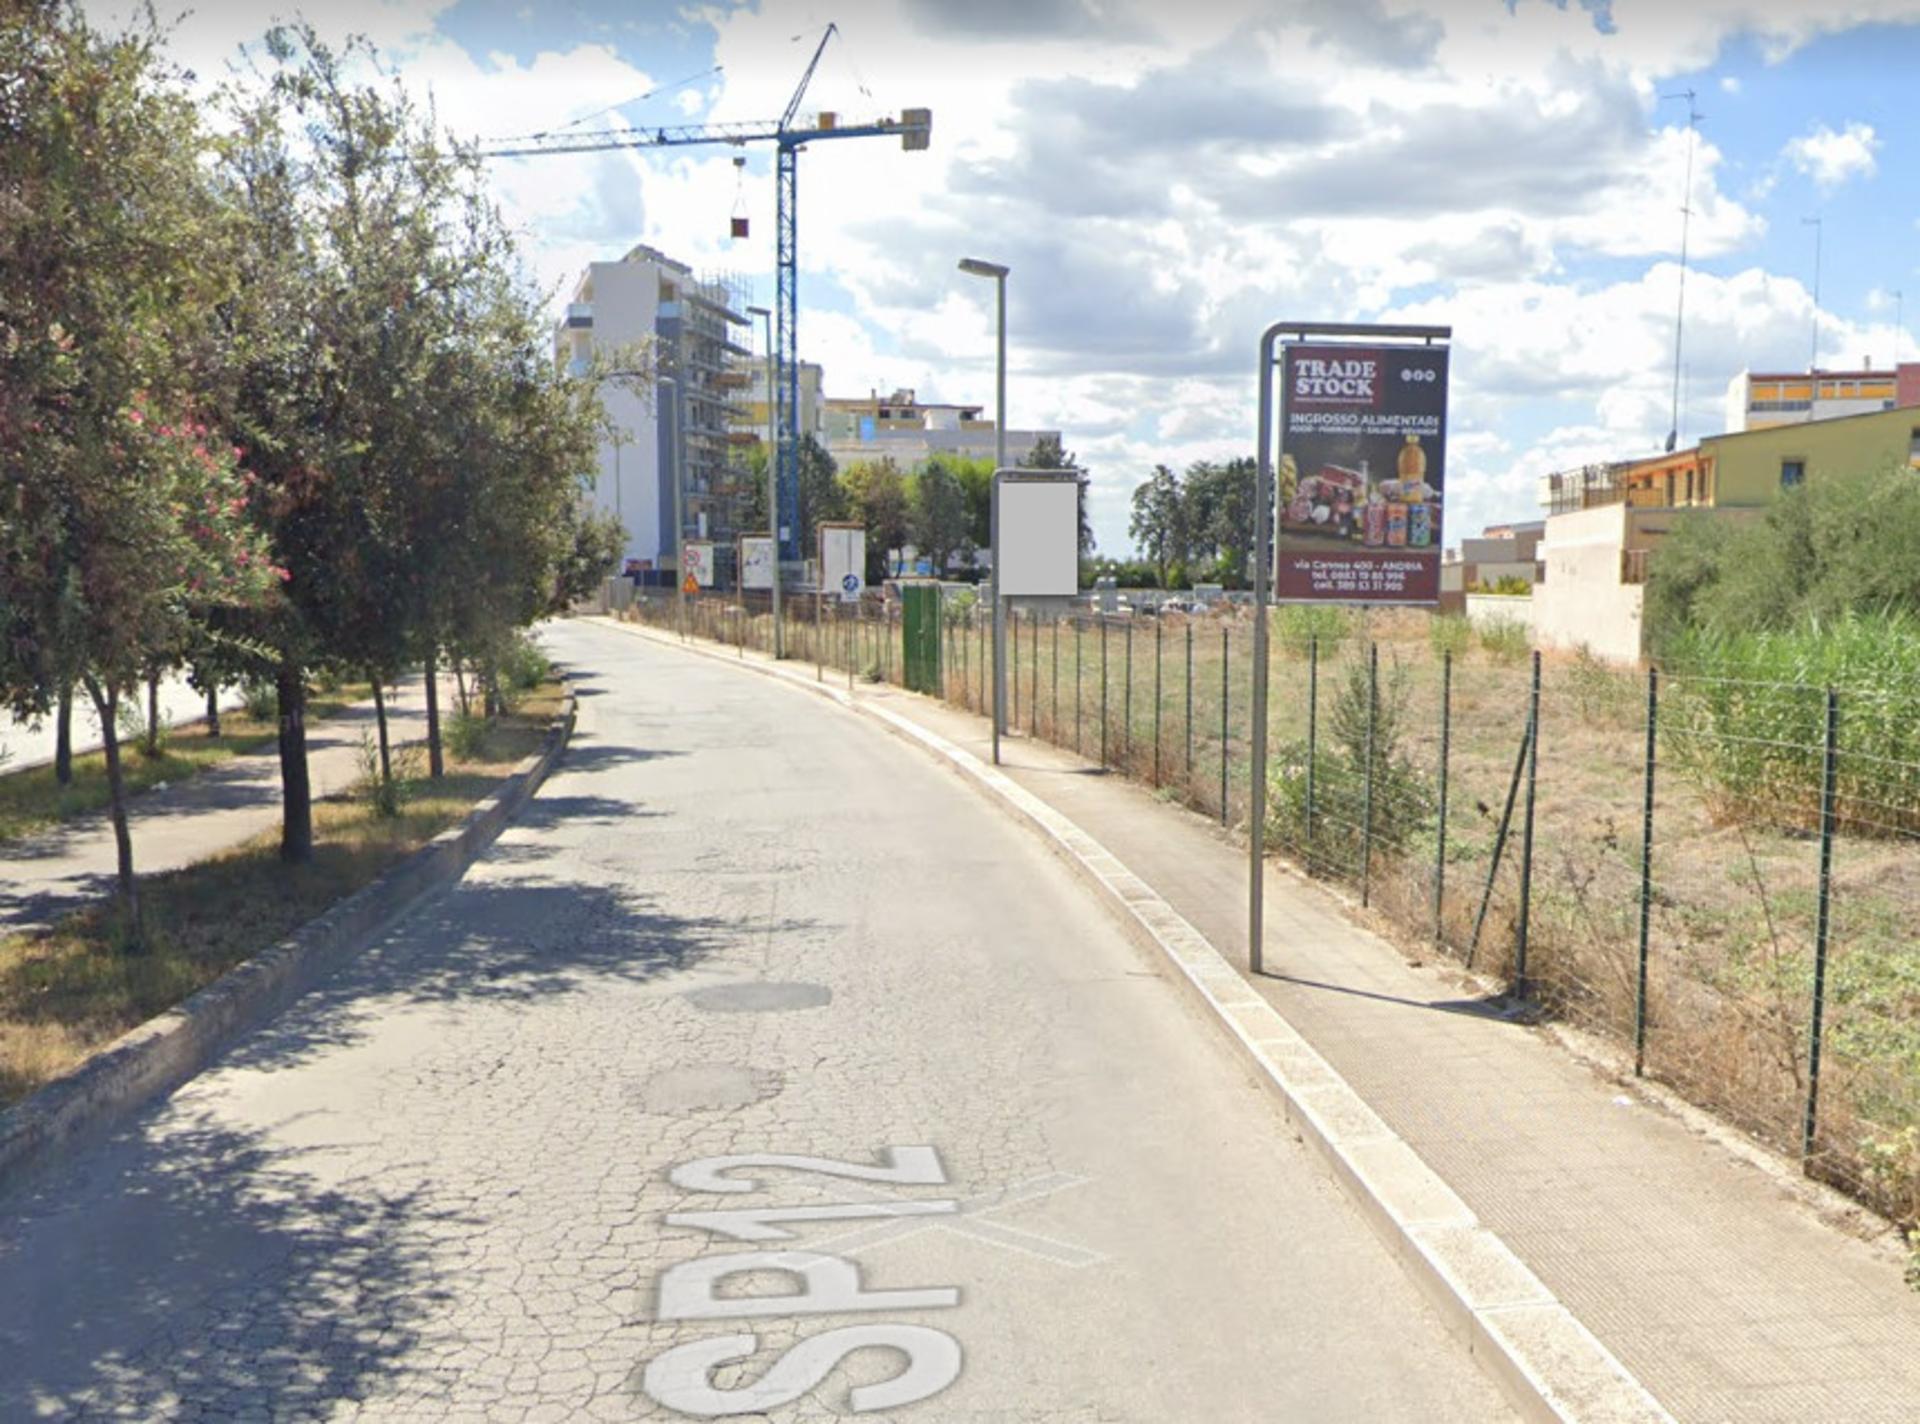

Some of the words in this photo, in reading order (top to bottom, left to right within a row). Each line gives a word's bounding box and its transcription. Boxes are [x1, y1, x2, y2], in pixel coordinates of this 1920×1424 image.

[1295, 359, 1376, 378] TRADE
[1295, 378, 1374, 396] STOCK
[1290, 413, 1358, 425] INGROSSO
[1361, 415, 1439, 427] ALIMENTARI
[1294, 559, 1310, 569] via
[1381, 561, 1423, 571] ANDRIA
